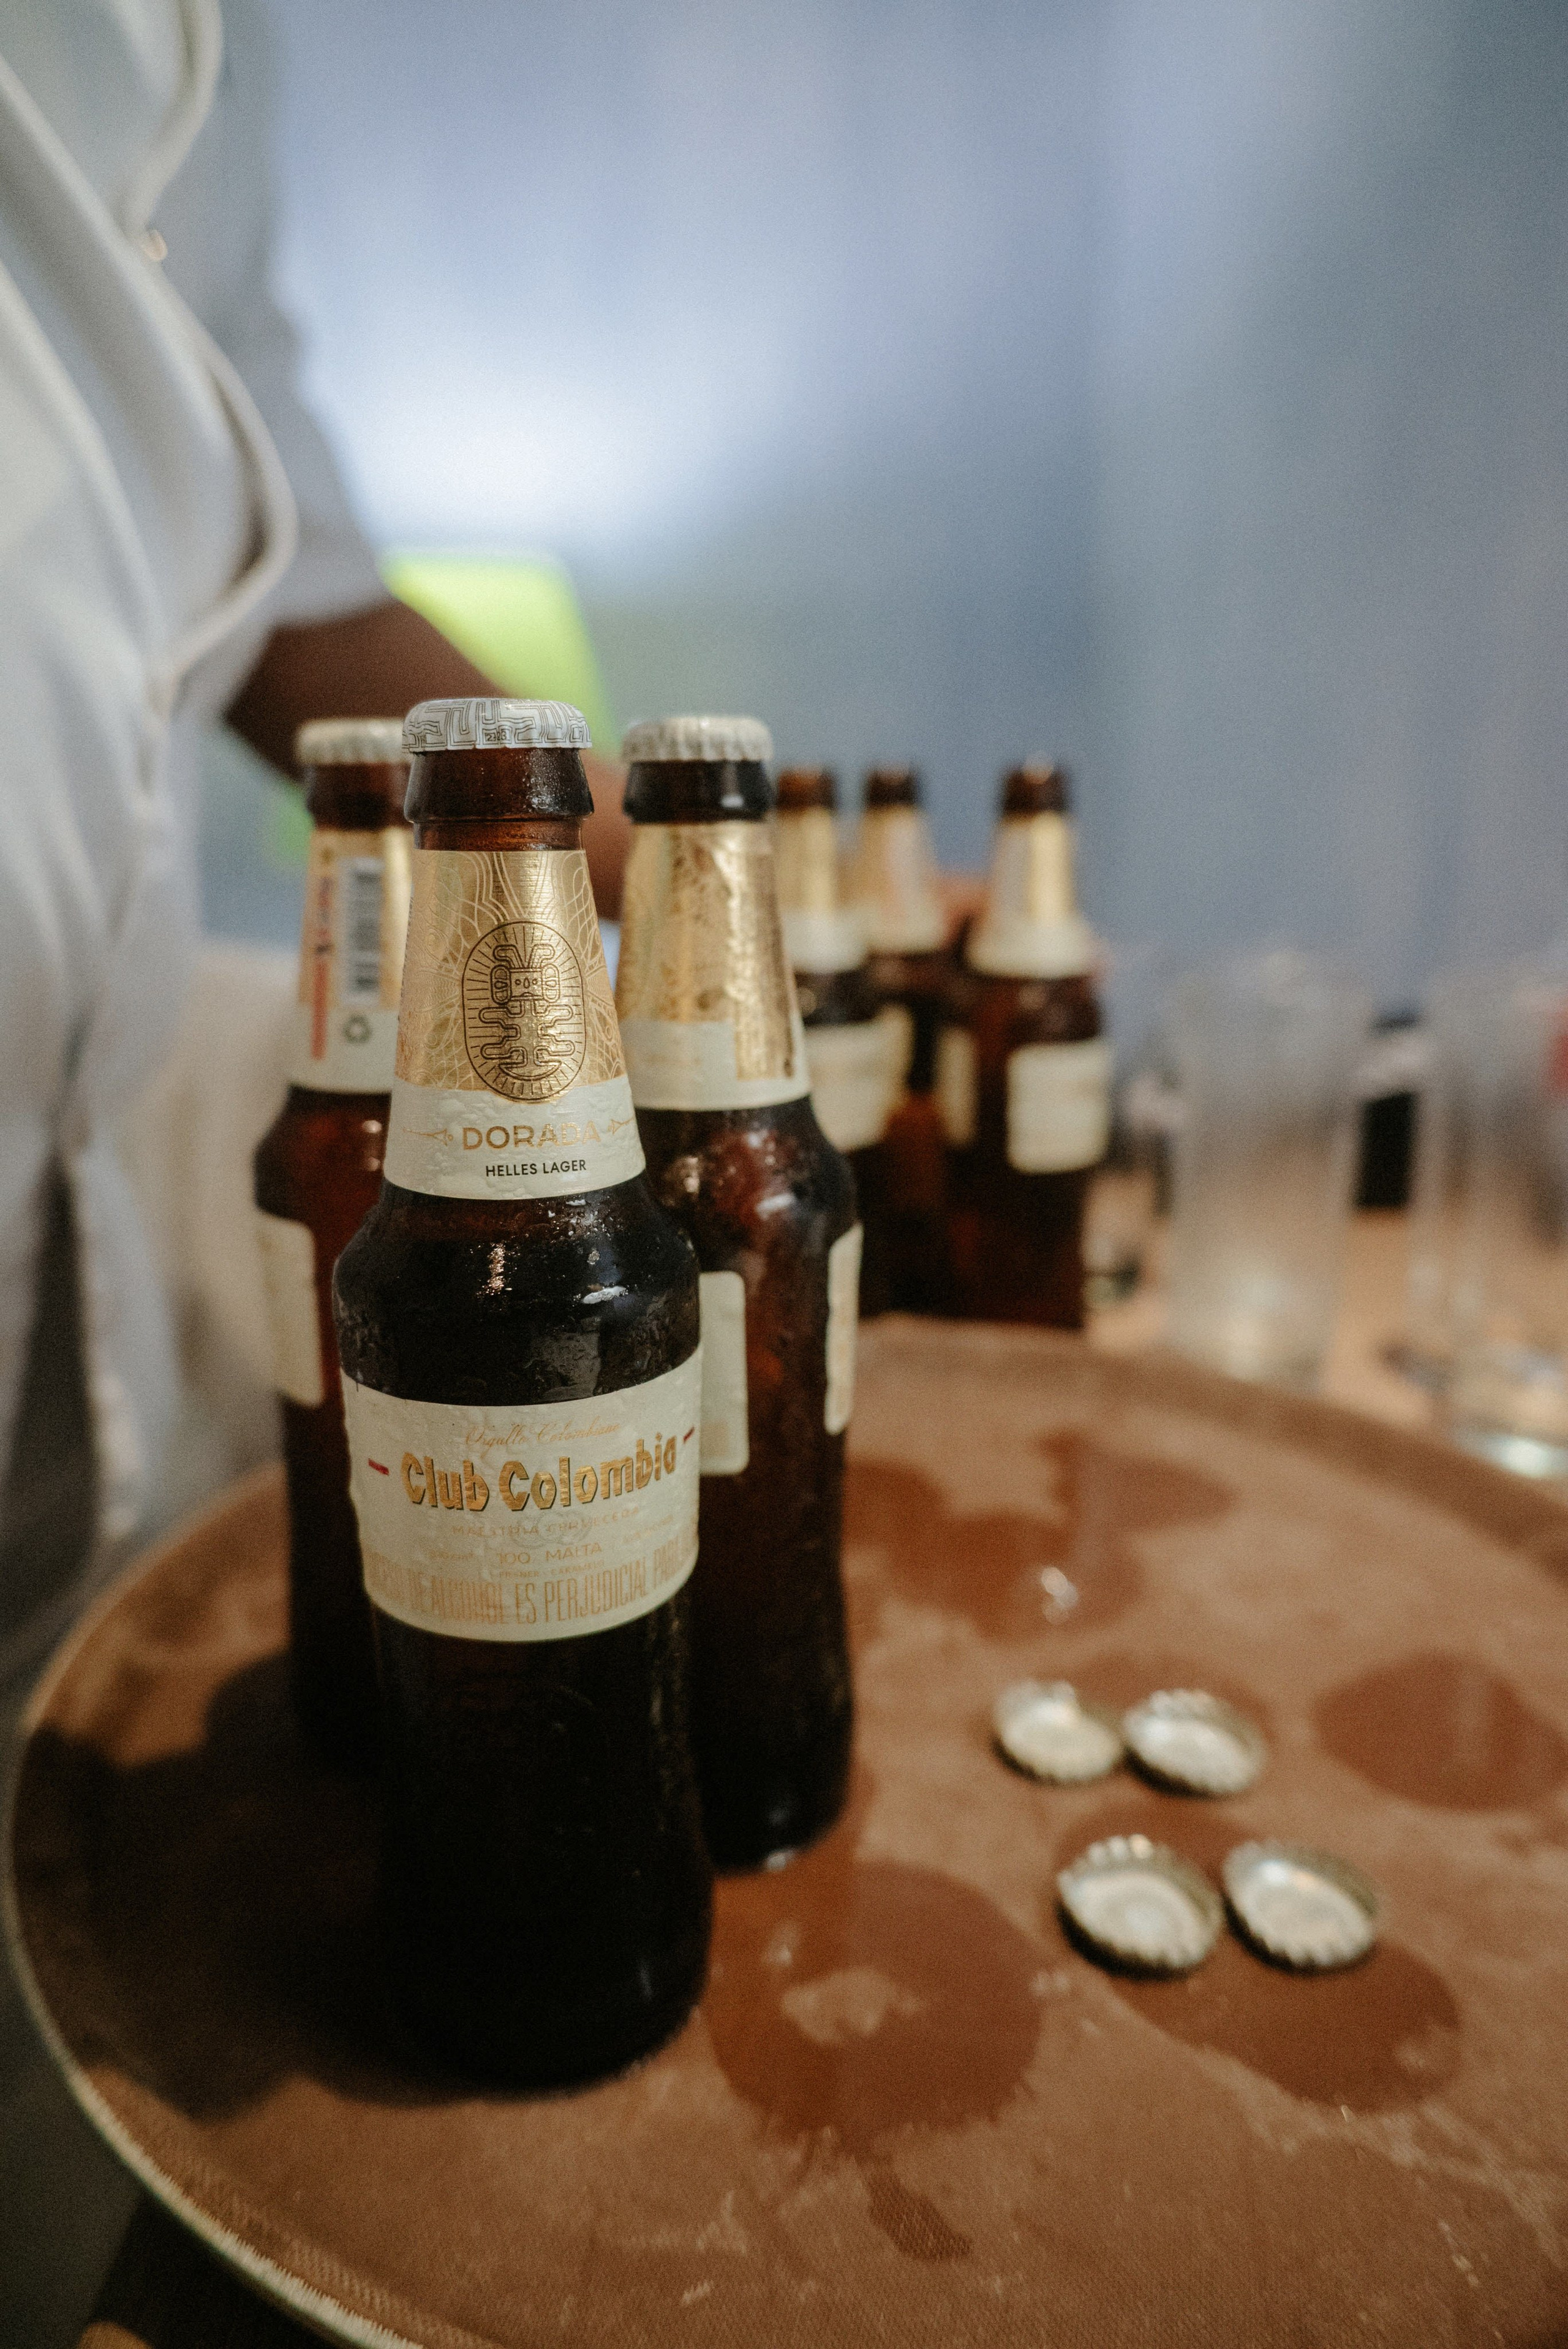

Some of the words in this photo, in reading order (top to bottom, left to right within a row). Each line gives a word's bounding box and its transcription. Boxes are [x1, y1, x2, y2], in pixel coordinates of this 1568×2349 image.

[462, 1120, 601, 1150] DORADA
[486, 1163, 537, 1177] HELLES
[543, 1159, 586, 1174] LAGER
[401, 1452, 489, 1512] Club
[498, 1432, 677, 1511] Colombia
[545, 1542, 602, 1562] MALTA
[515, 1582, 537, 1625] ES
[544, 1555, 647, 1623] PERJUDICIAL
